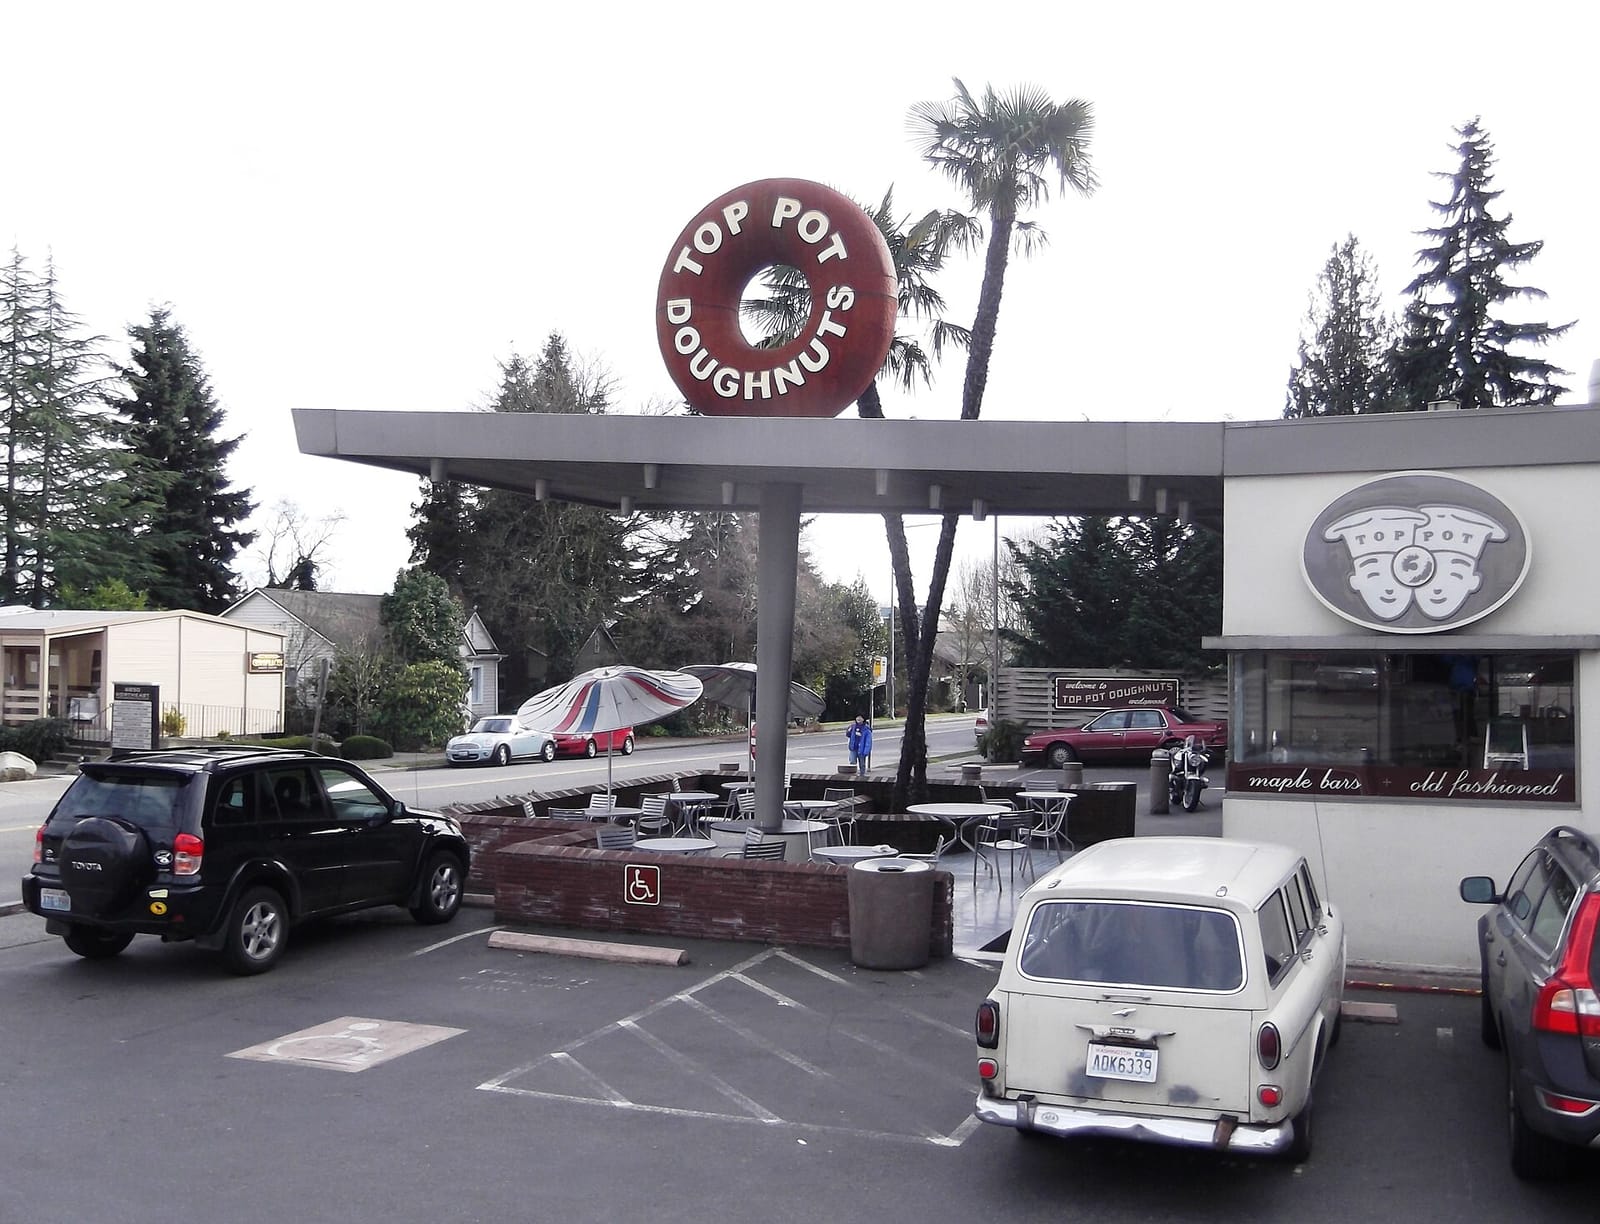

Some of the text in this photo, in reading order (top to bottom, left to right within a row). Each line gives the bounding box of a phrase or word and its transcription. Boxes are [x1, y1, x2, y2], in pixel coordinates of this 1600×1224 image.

[673, 197, 848, 275] TOP POT
[667, 285, 855, 400] DOUGHNUTS
[1355, 530, 1473, 545] TOP POT
[1062, 682, 1173, 704] TOP POT DOUGHNUTS
[1065, 681, 1107, 690] welcome to
[1249, 768, 1564, 797] maple bars old fashioned
[71, 861, 103, 871] TOYOTA
[1093, 1055, 1152, 1075] ADK6339
